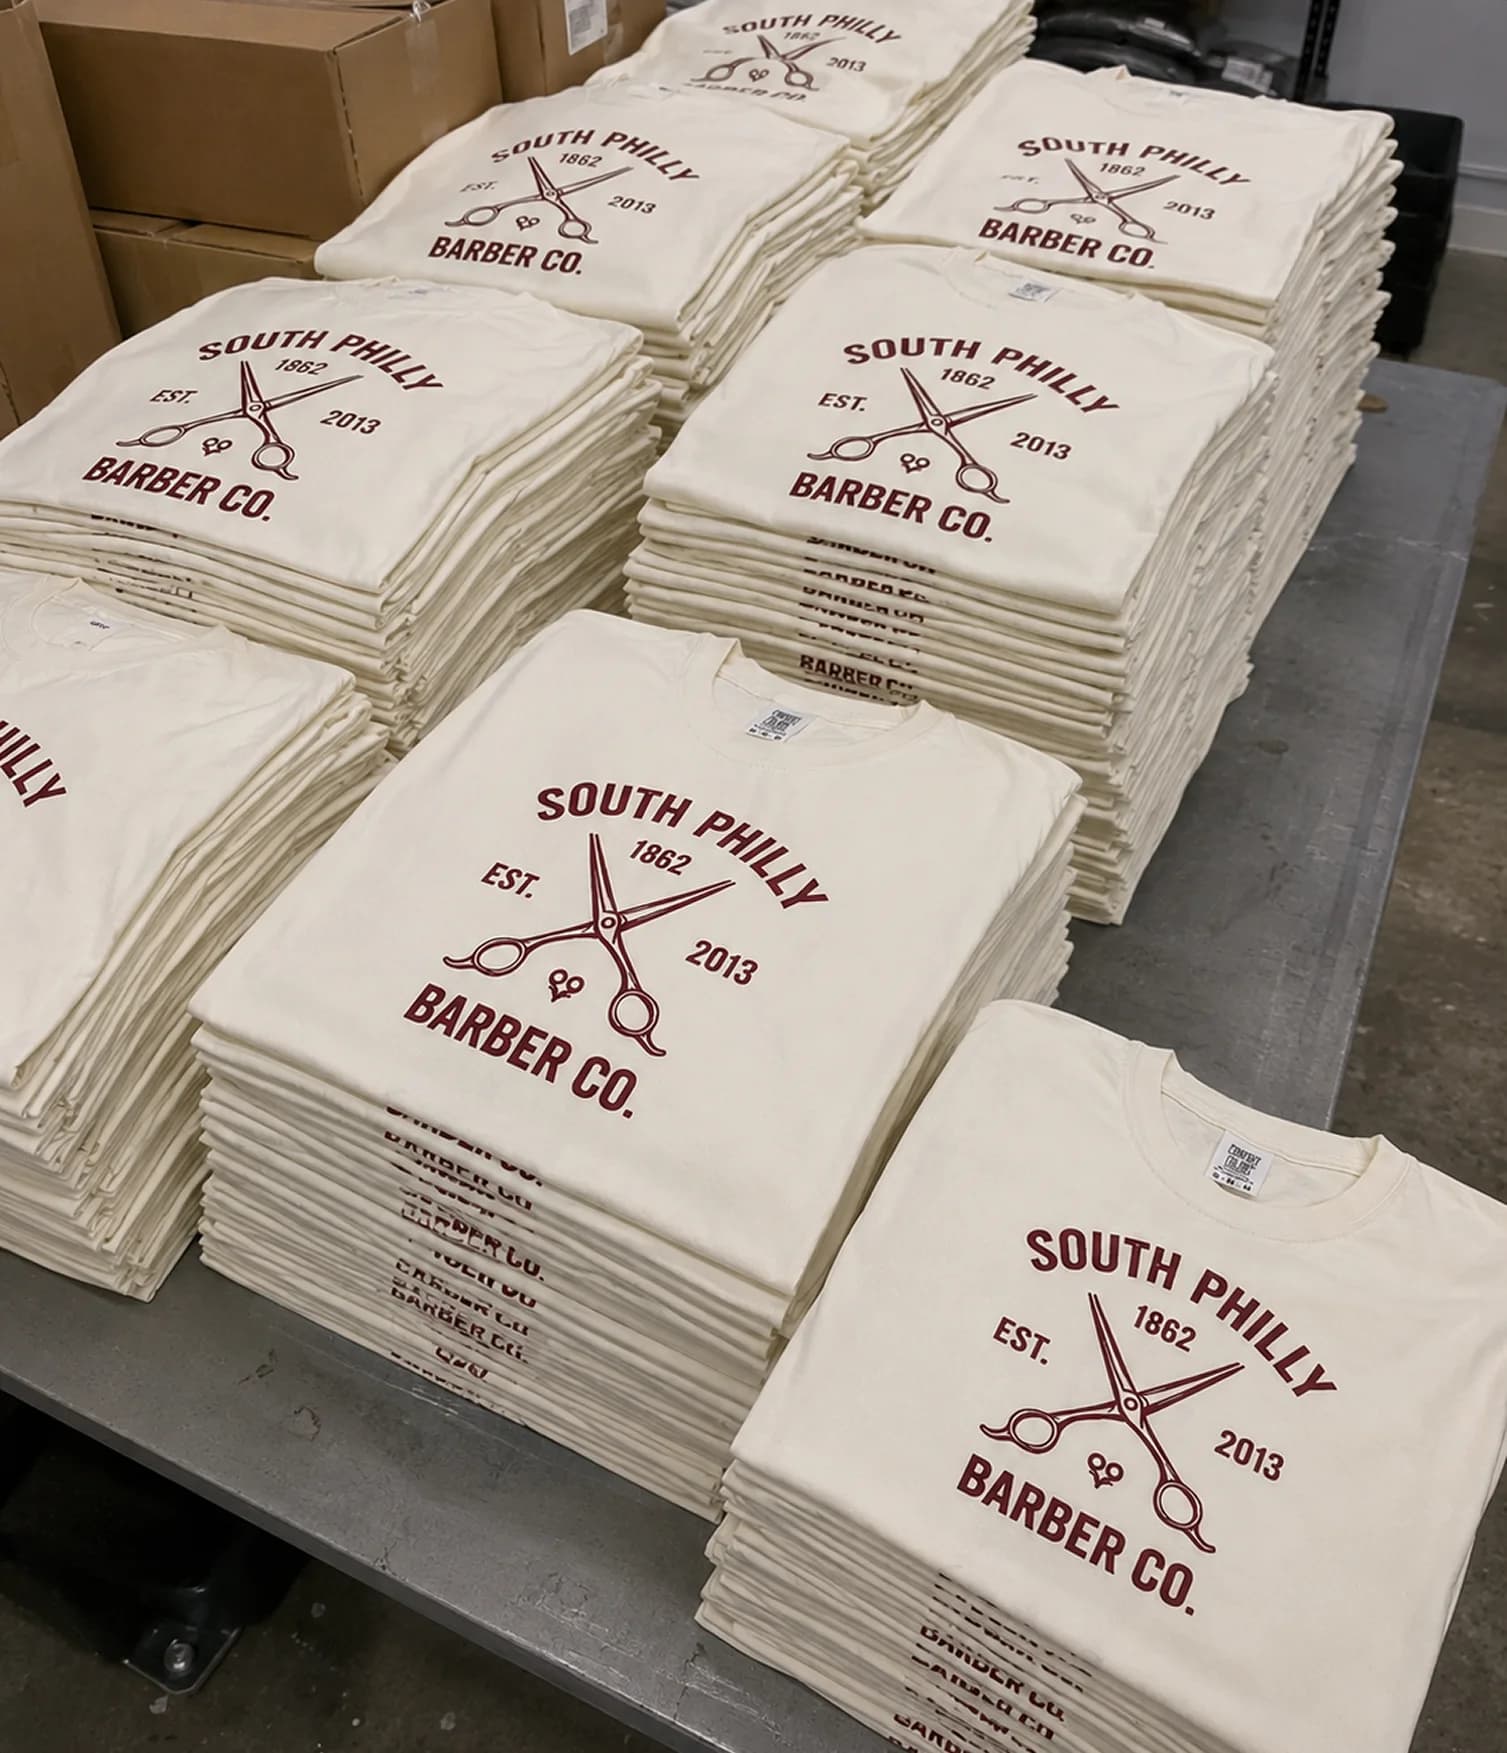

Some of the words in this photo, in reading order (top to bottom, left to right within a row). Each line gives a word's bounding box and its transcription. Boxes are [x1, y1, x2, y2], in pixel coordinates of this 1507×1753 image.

[723, 14, 813, 33] SOUTH
[818, 14, 901, 43] PHILLY
[827, 57, 866, 72] 2013
[491, 130, 595, 162] SOUTH
[600, 132, 699, 180] PHILLY
[560, 153, 602, 168] 1862
[1018, 137, 1130, 157] SOUTH
[1139, 145, 1250, 185] PHILLY
[1100, 163, 1145, 176] 1862
[608, 196, 656, 214] 2013
[1164, 201, 1215, 219] 2013
[428, 236, 538, 268] BARBER
[541, 250, 582, 275] CO.
[979, 219, 1102, 258] BARBER
[1107, 244, 1154, 268] CO.
[199, 330, 329, 360] SOUTH
[329, 334, 443, 390] PHILLY
[275, 359, 328, 375] 1862
[843, 337, 982, 364] SOUTH
[991, 347, 1120, 413] PHILLY
[941, 368, 995, 390] 1862
[149, 390, 198, 404] EST.
[818, 393, 867, 411] EST.
[320, 410, 381, 434] 2013
[1010, 432, 1071, 460] 2013
[82, 457, 221, 505] BARBER
[219, 484, 275, 521] CO.
[789, 472, 932, 524] BARBER
[938, 505, 992, 543] CO.
[537, 782, 693, 828] SOUTH
[692, 810, 829, 909] PHILLY
[630, 840, 692, 876] 1862
[481, 862, 540, 898] EST.
[685, 940, 758, 985] 2013
[403, 983, 572, 1083] BARBER
[572, 1056, 637, 1119] CO.
[1027, 1228, 1182, 1291] SOUTH
[1190, 1269, 1337, 1397] PHILLY
[1134, 1305, 1196, 1352] 1862
[993, 1317, 1051, 1365] EST.
[1214, 1430, 1284, 1481] 2013
[957, 1453, 1126, 1575] BARBER
[1131, 1548, 1194, 1616] CO.
